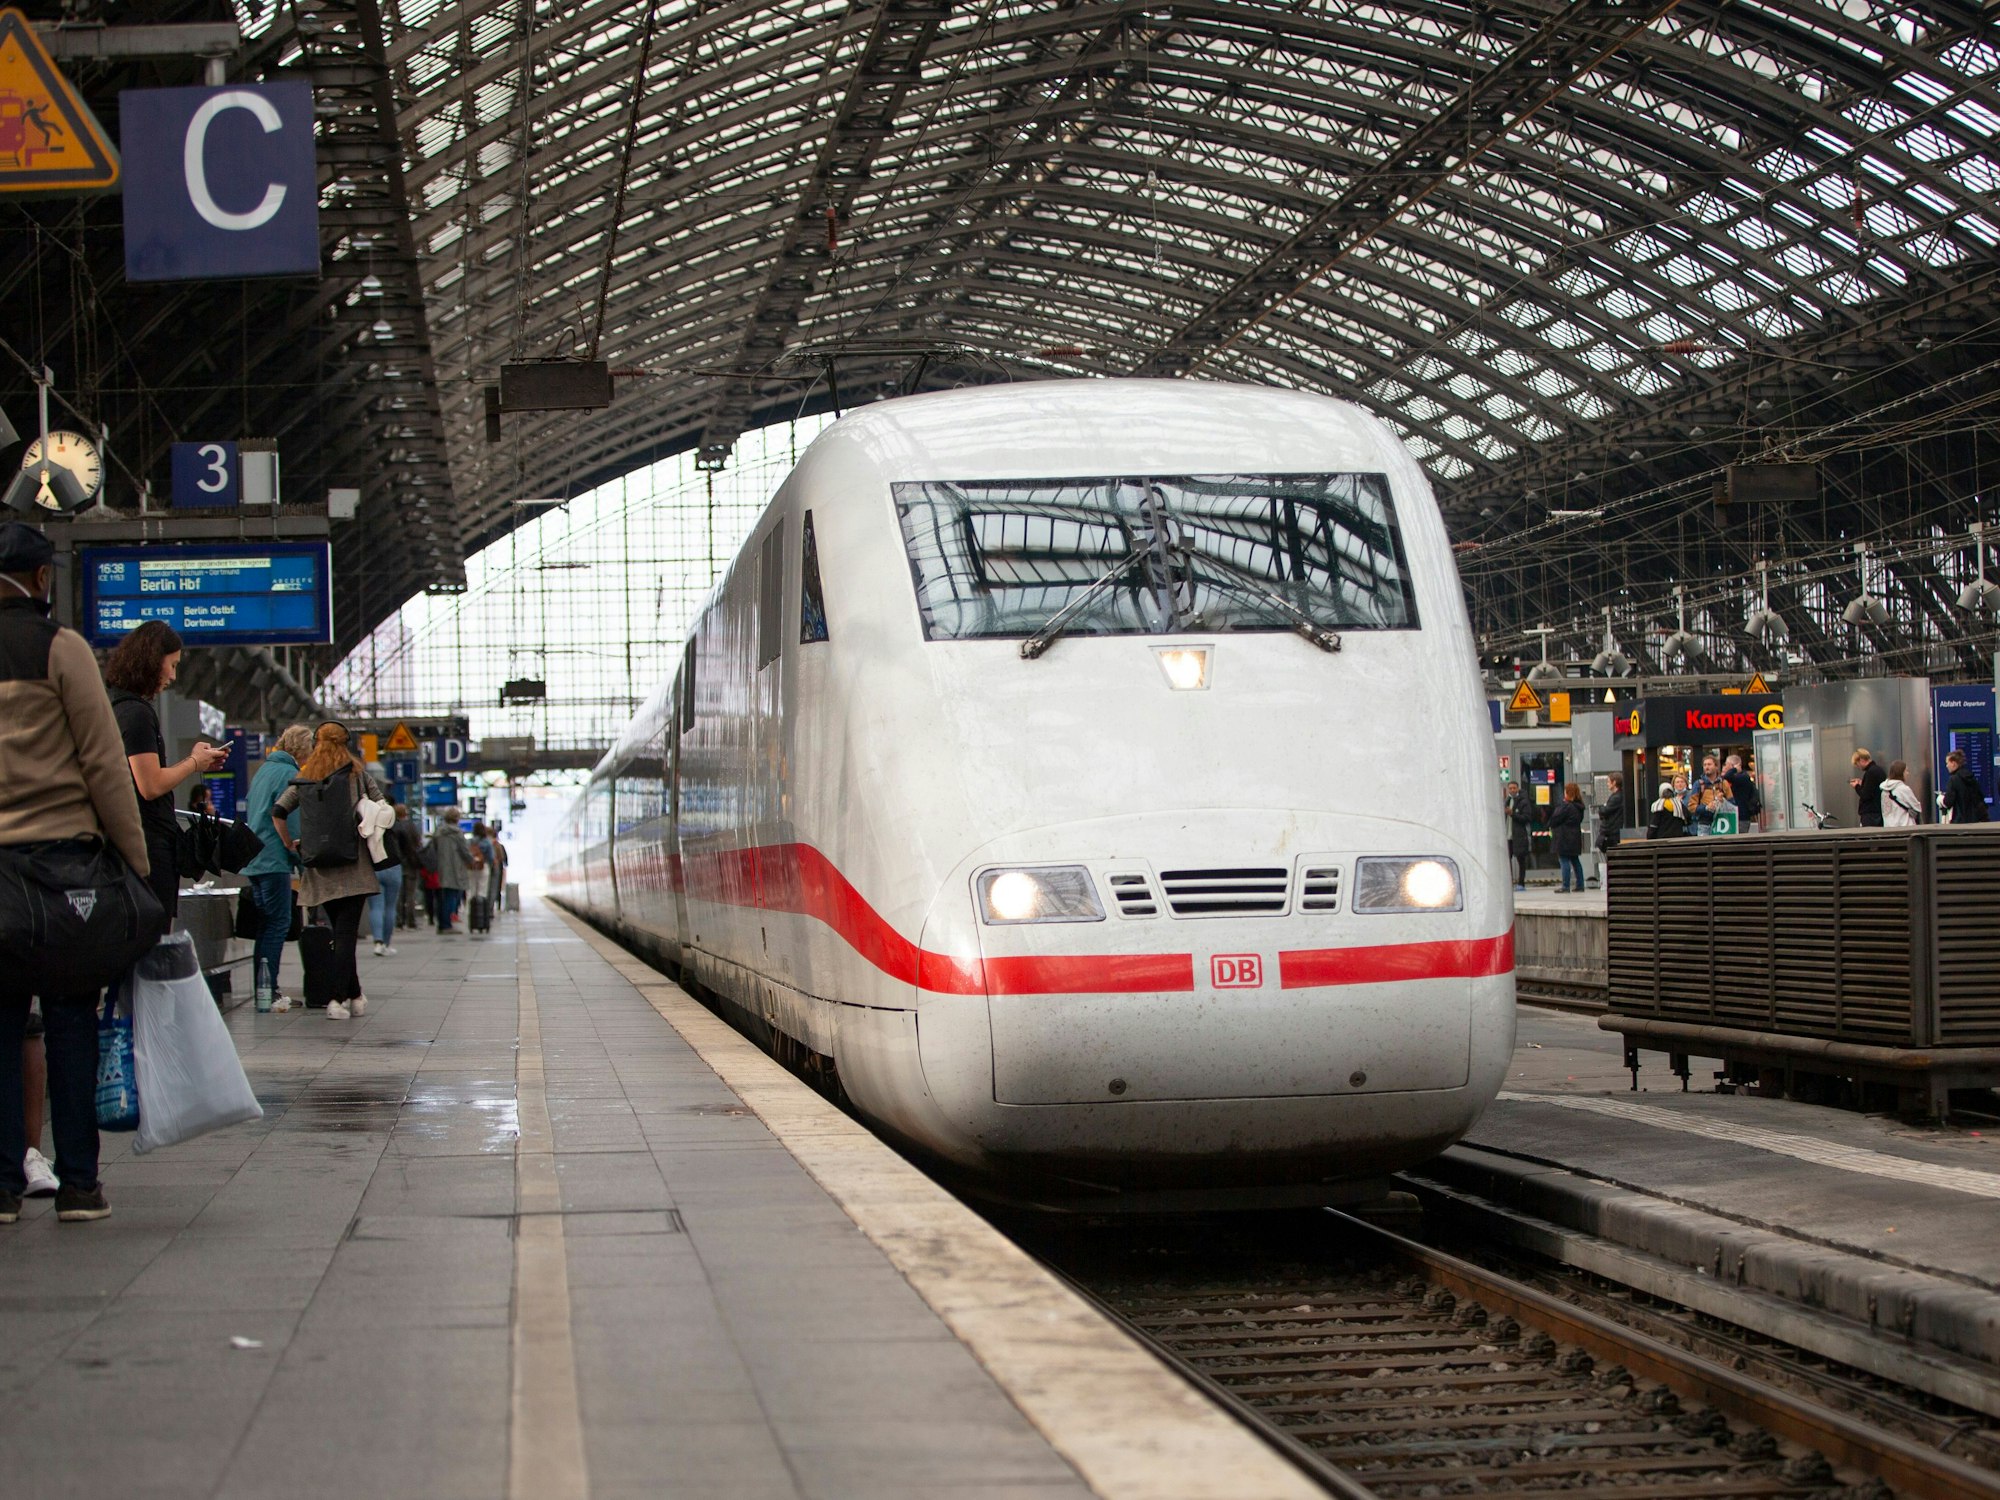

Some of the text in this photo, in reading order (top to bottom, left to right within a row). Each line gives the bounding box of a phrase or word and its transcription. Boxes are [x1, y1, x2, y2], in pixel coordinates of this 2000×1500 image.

[183, 90, 288, 231] C
[196, 443, 229, 493] 3
[98, 563, 125, 574] 16:38
[140, 577, 201, 591] Berlin Hbf
[99, 608, 123, 618] 16:38
[140, 607, 174, 616] ICE 1153
[183, 605, 237, 615] Berlin Ostbf.
[183, 618, 225, 628] Dortmund
[1939, 700, 1962, 708] Abfahrt
[1685, 709, 1757, 733] Kamps
[445, 738, 465, 764] D
[1216, 958, 1257, 984] DB
